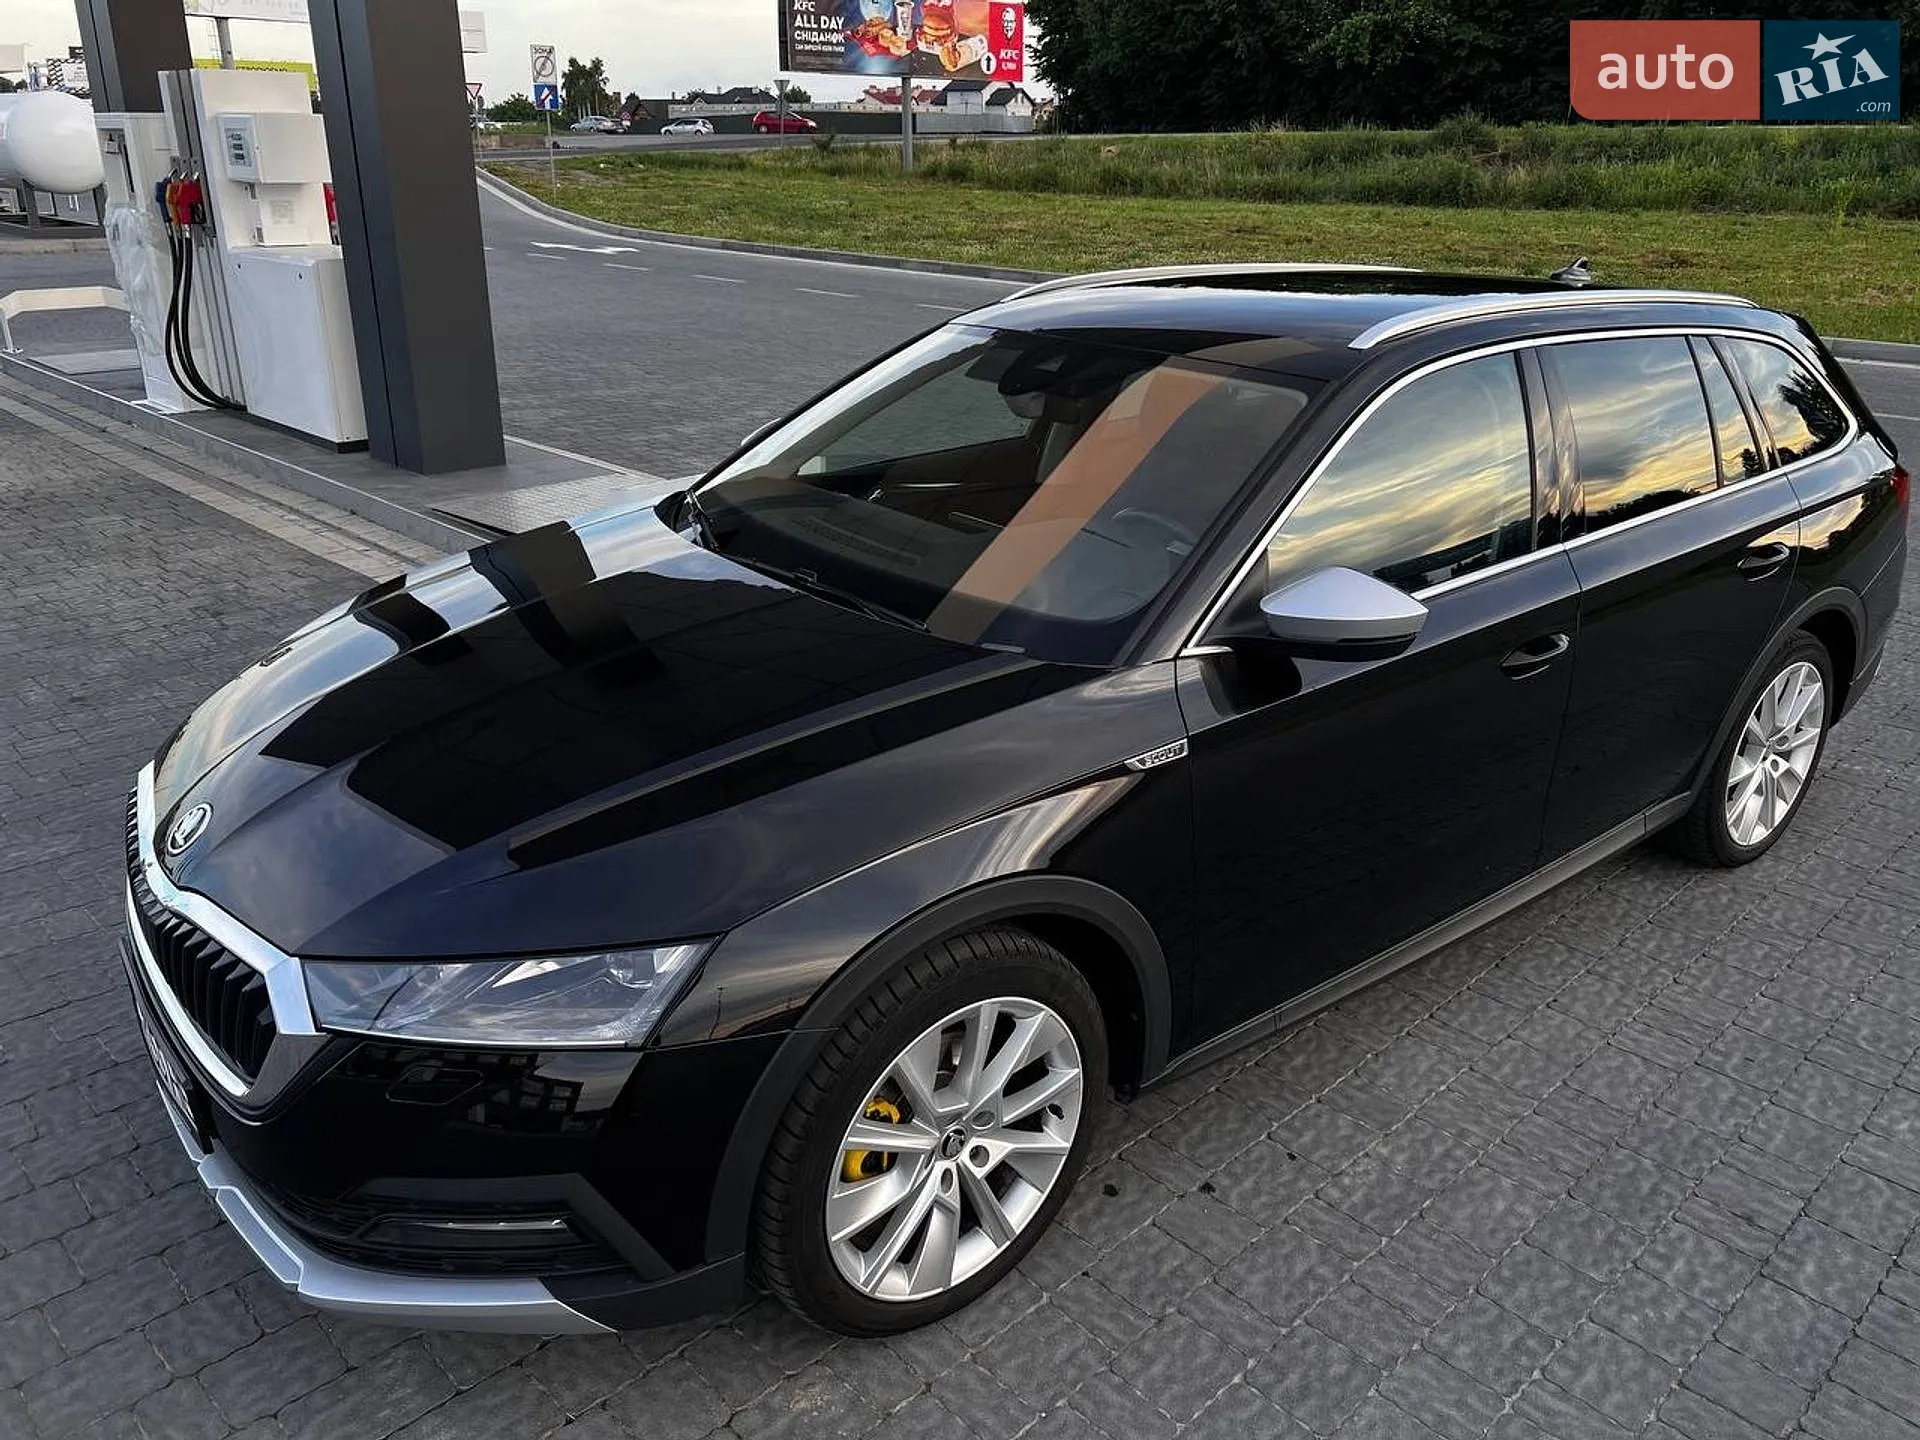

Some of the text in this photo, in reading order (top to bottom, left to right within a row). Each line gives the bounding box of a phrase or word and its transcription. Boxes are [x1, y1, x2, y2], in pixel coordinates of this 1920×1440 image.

[793, 0, 815, 11] KFC
[794, 14, 845, 29] ALL DAY
[794, 31, 845, 43] СНІДАНОК
[999, 49, 1020, 60] KFC
[1145, 745, 1181, 767] SCOUT
